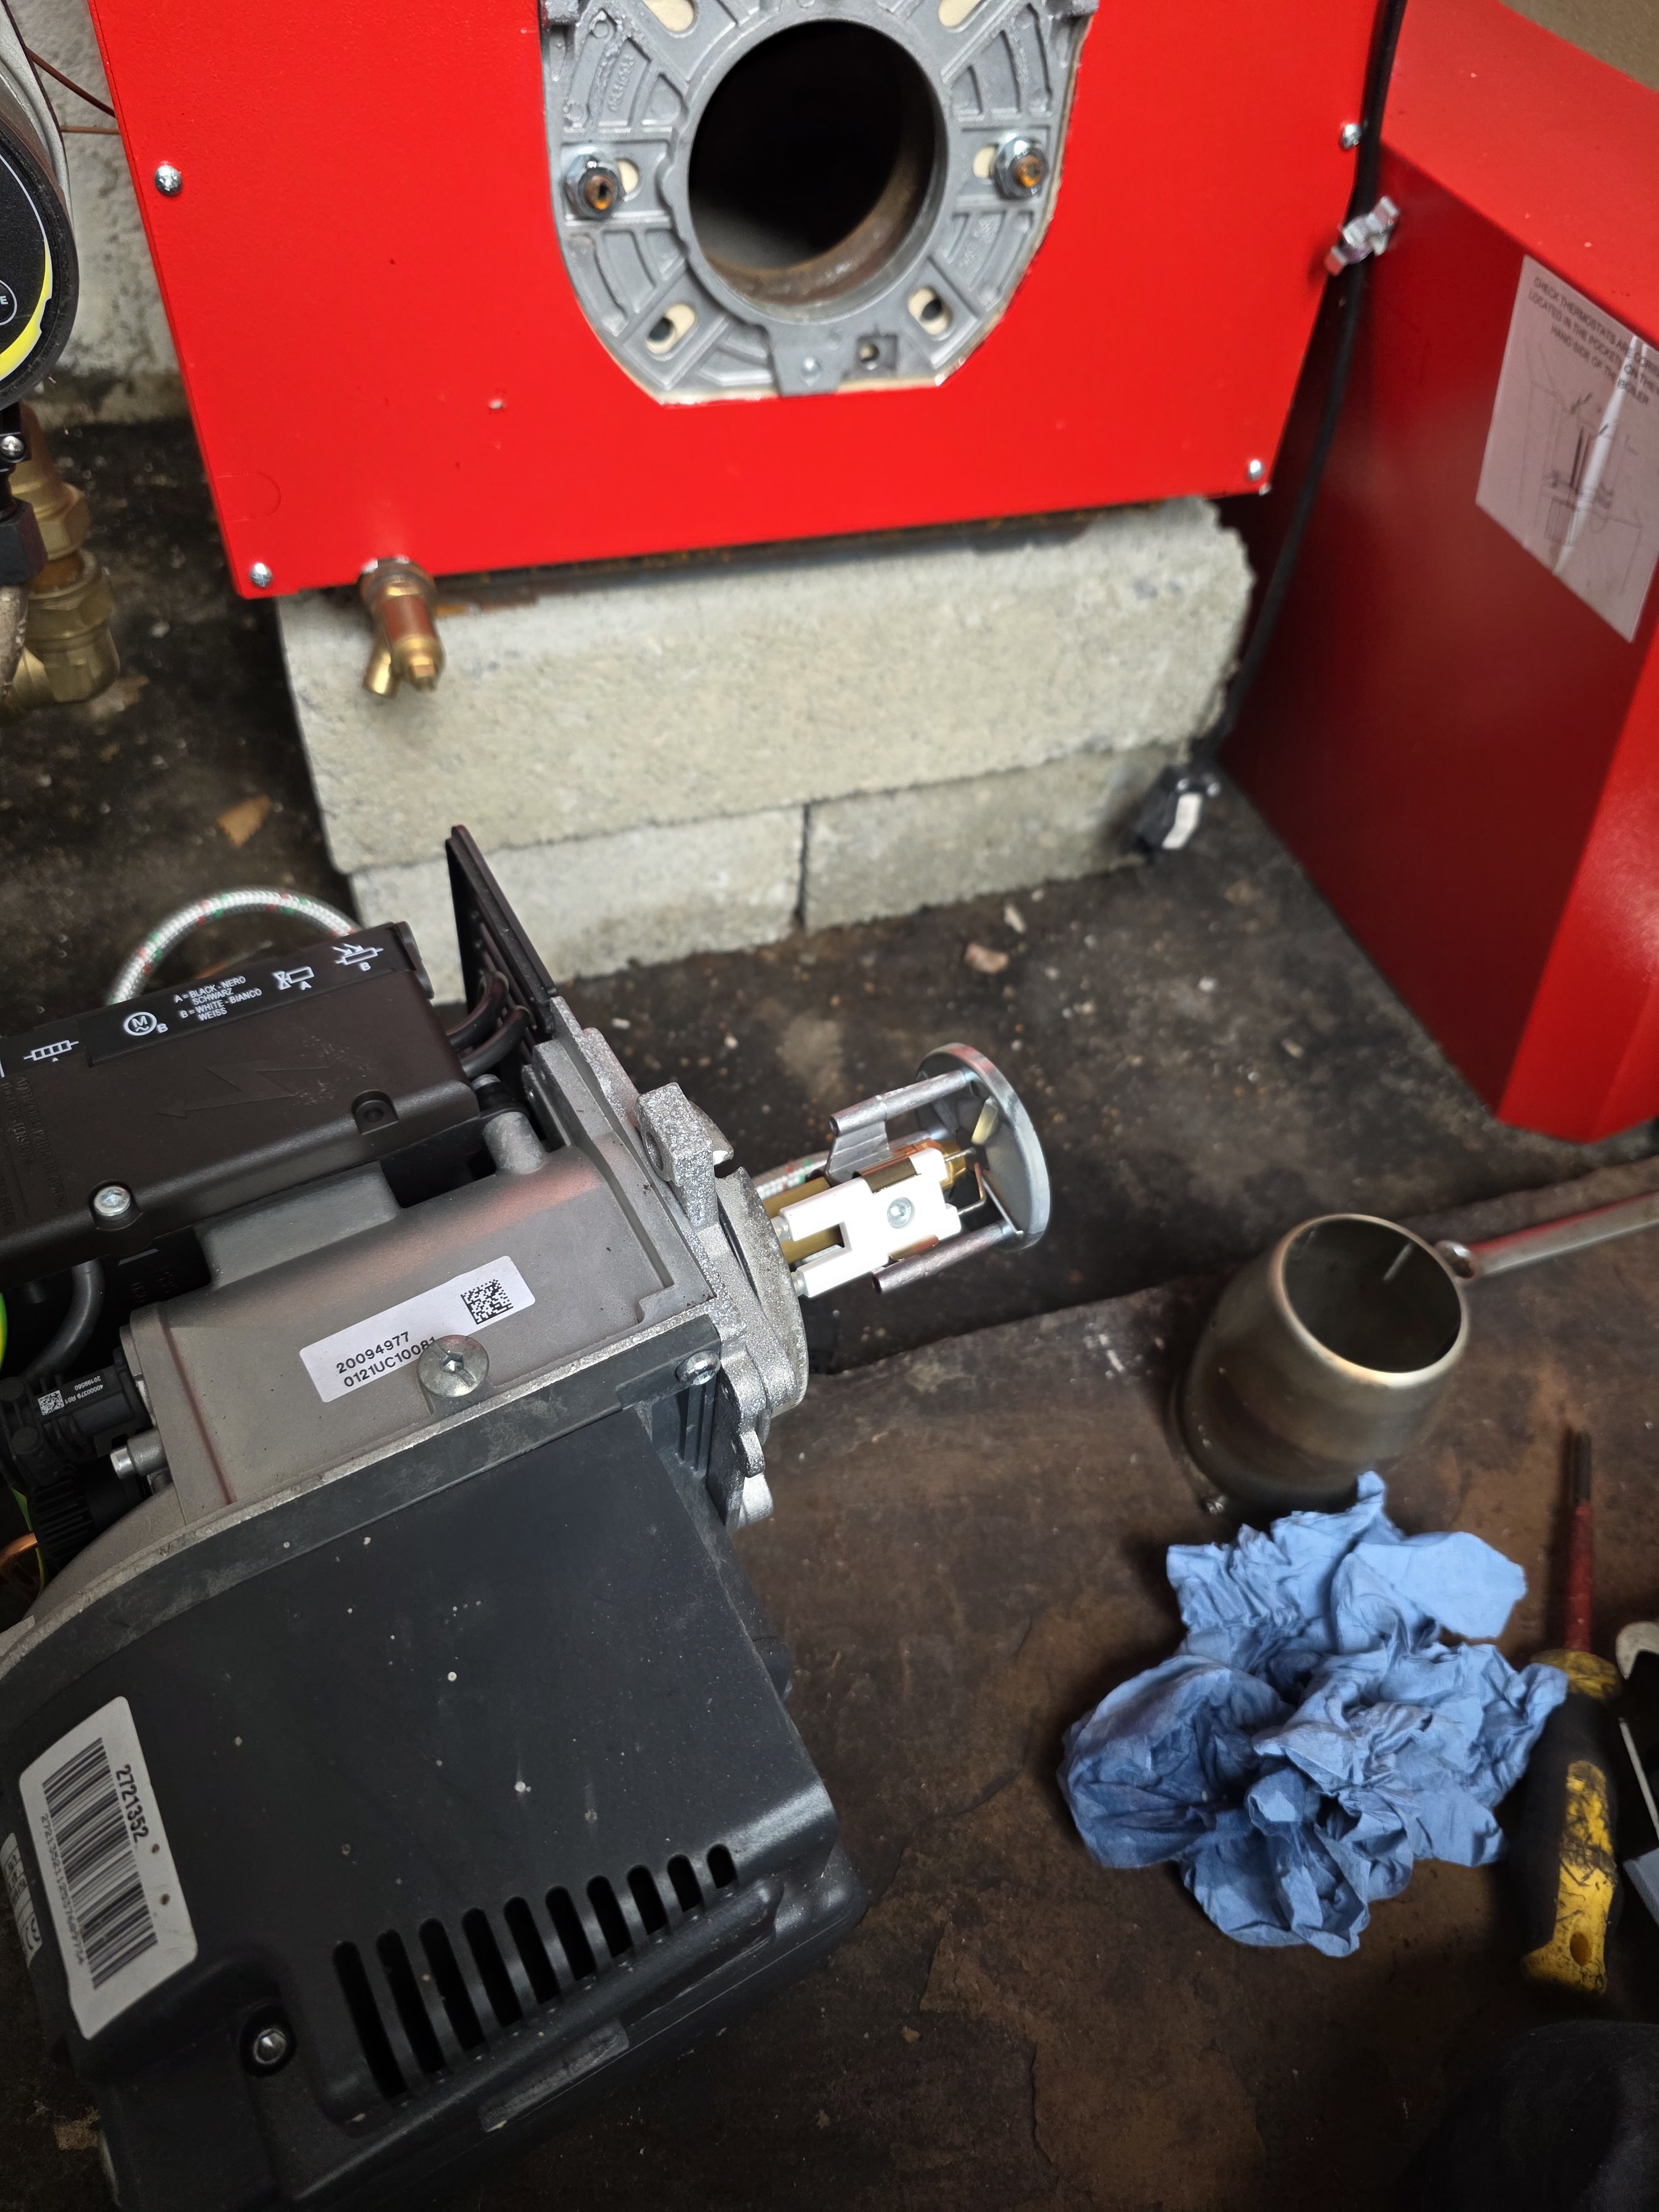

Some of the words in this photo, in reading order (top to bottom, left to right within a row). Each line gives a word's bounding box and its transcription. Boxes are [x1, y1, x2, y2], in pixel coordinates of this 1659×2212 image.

[1528, 288, 1562, 322] LOCATED
[1563, 316, 1572, 328] IN
[1573, 322, 1589, 342] THE
[1561, 295, 1616, 345] THERMOSTATS
[1551, 322, 1572, 348] HAND
[1572, 340, 1590, 363] SIDE
[1590, 354, 1603, 369] OF
[1617, 378, 1650, 405] BOILER
[360, 962, 371, 972] B
[189, 984, 217, 998] BLACK
[221, 975, 246, 989] NERO
[192, 988, 234, 1005] SCHWARZ
[300, 980, 312, 990] A
[195, 1000, 225, 1015] WHITE
[229, 988, 263, 1004] BIANCO
[198, 1007, 227, 1021] WEISS
[156, 1022, 168, 1034] B
[336, 1331, 409, 1374] 20094977
[65, 1395, 76, 1405] R01
[116, 1763, 149, 1844] 2721352
